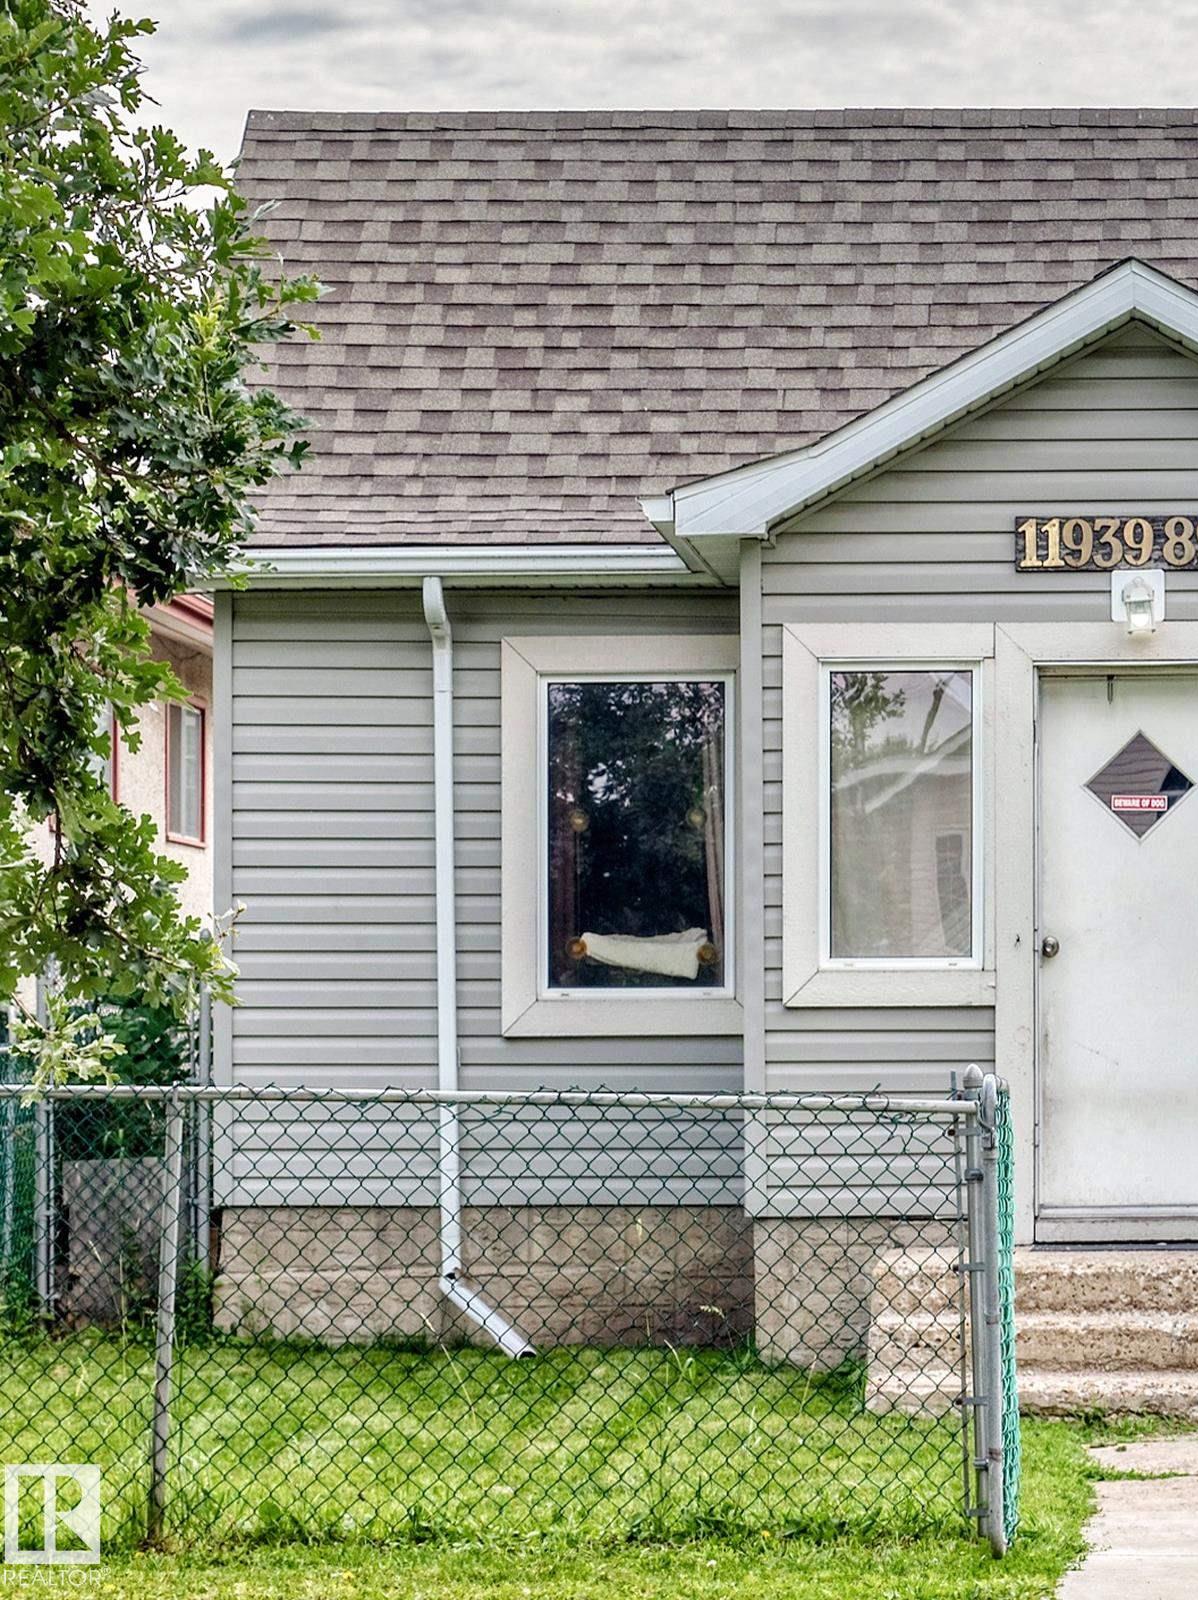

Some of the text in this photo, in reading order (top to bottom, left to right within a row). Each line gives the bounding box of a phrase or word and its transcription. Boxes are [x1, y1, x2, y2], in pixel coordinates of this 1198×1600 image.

[1018, 518, 1154, 568] 11939
[1114, 798, 1165, 808] BEWARE OF DOG
